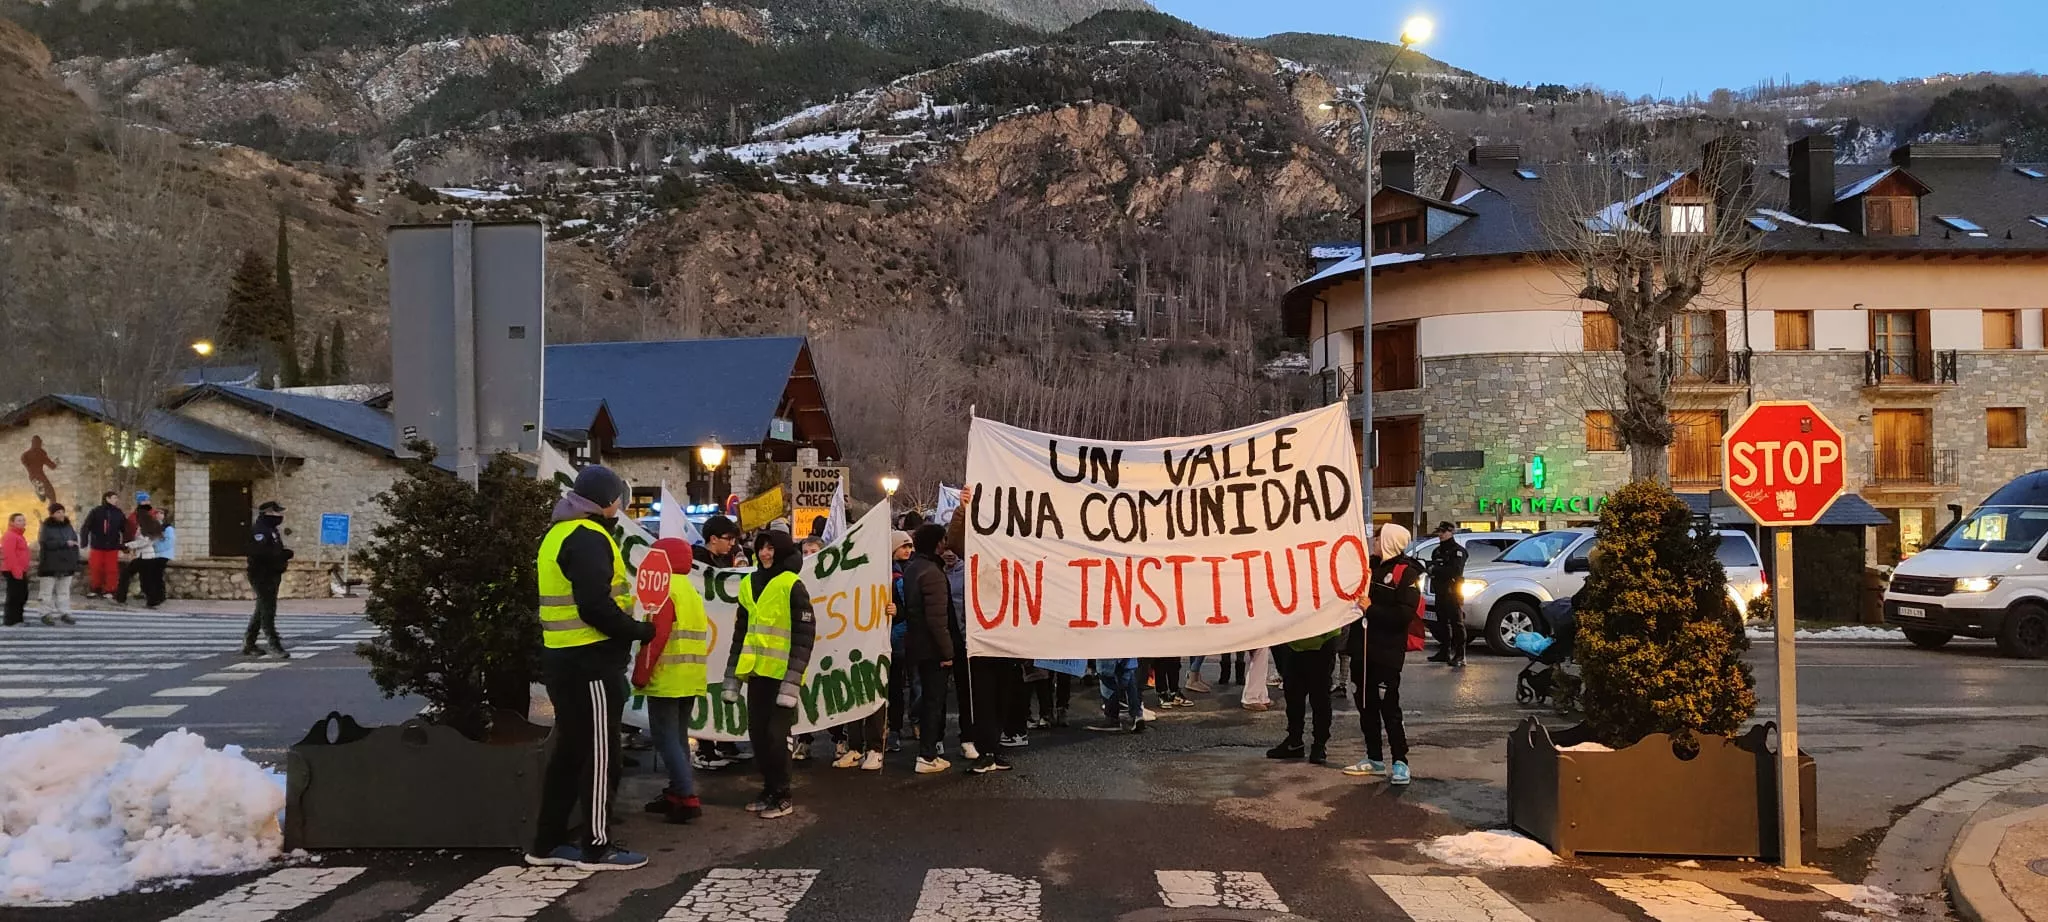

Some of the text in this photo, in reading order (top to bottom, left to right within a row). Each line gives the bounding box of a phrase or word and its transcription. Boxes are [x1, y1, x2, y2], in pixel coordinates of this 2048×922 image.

[803, 468, 840, 479] TODOS
[1049, 427, 1298, 489] UN VALLE
[1731, 440, 1839, 487] STOP
[970, 464, 1351, 544] UNA COMUNIDAD
[814, 523, 870, 580] DE
[639, 569, 669, 592] STOP
[970, 534, 1369, 630] UN INSTITUTO
